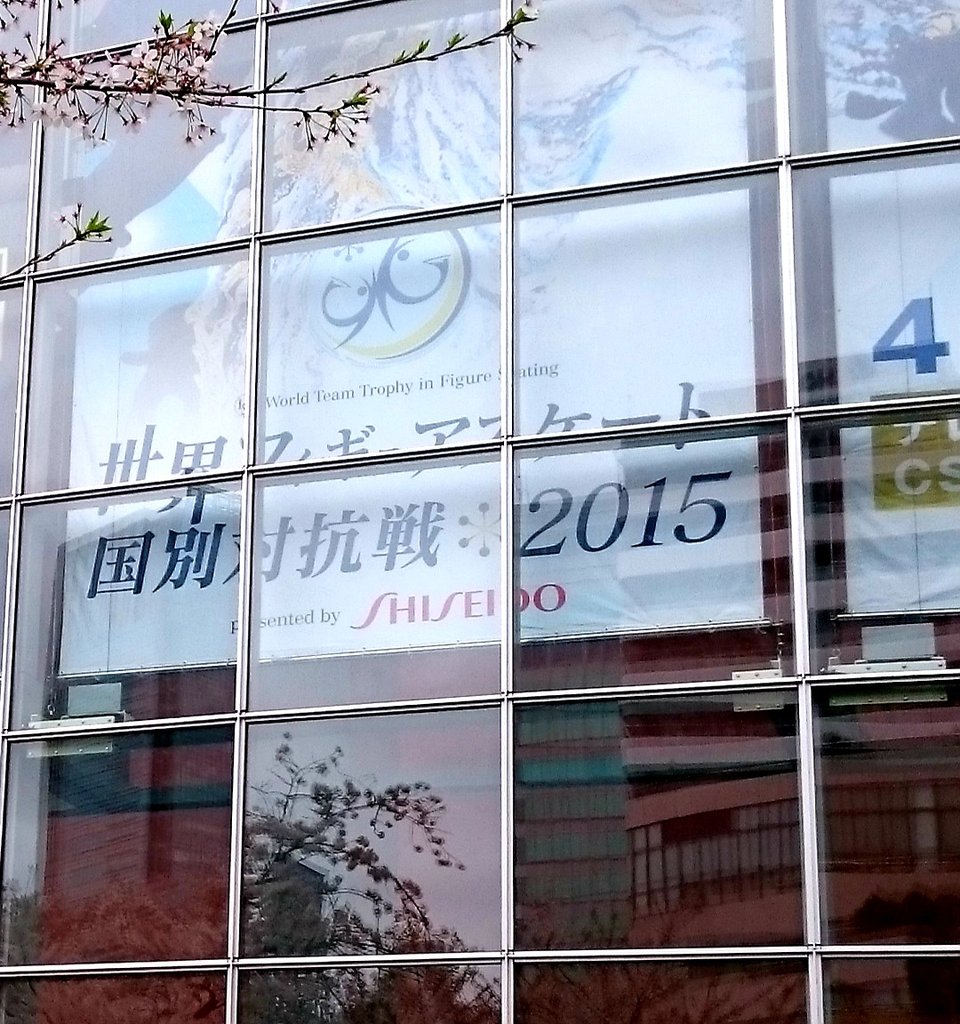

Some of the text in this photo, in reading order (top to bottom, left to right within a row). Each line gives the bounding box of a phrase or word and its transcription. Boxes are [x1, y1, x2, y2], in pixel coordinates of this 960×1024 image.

[873, 297, 950, 374] 4
[266, 389, 310, 408] World
[314, 386, 356, 403] Team
[359, 380, 414, 400] Trophy
[418, 377, 434, 391] in
[440, 370, 492, 390] Figure
[498, 362, 559, 381] ating
[86, 470, 733, 599] 国別対抗戦 2015
[230, 608, 314, 634] psented
[320, 607, 341, 627] by
